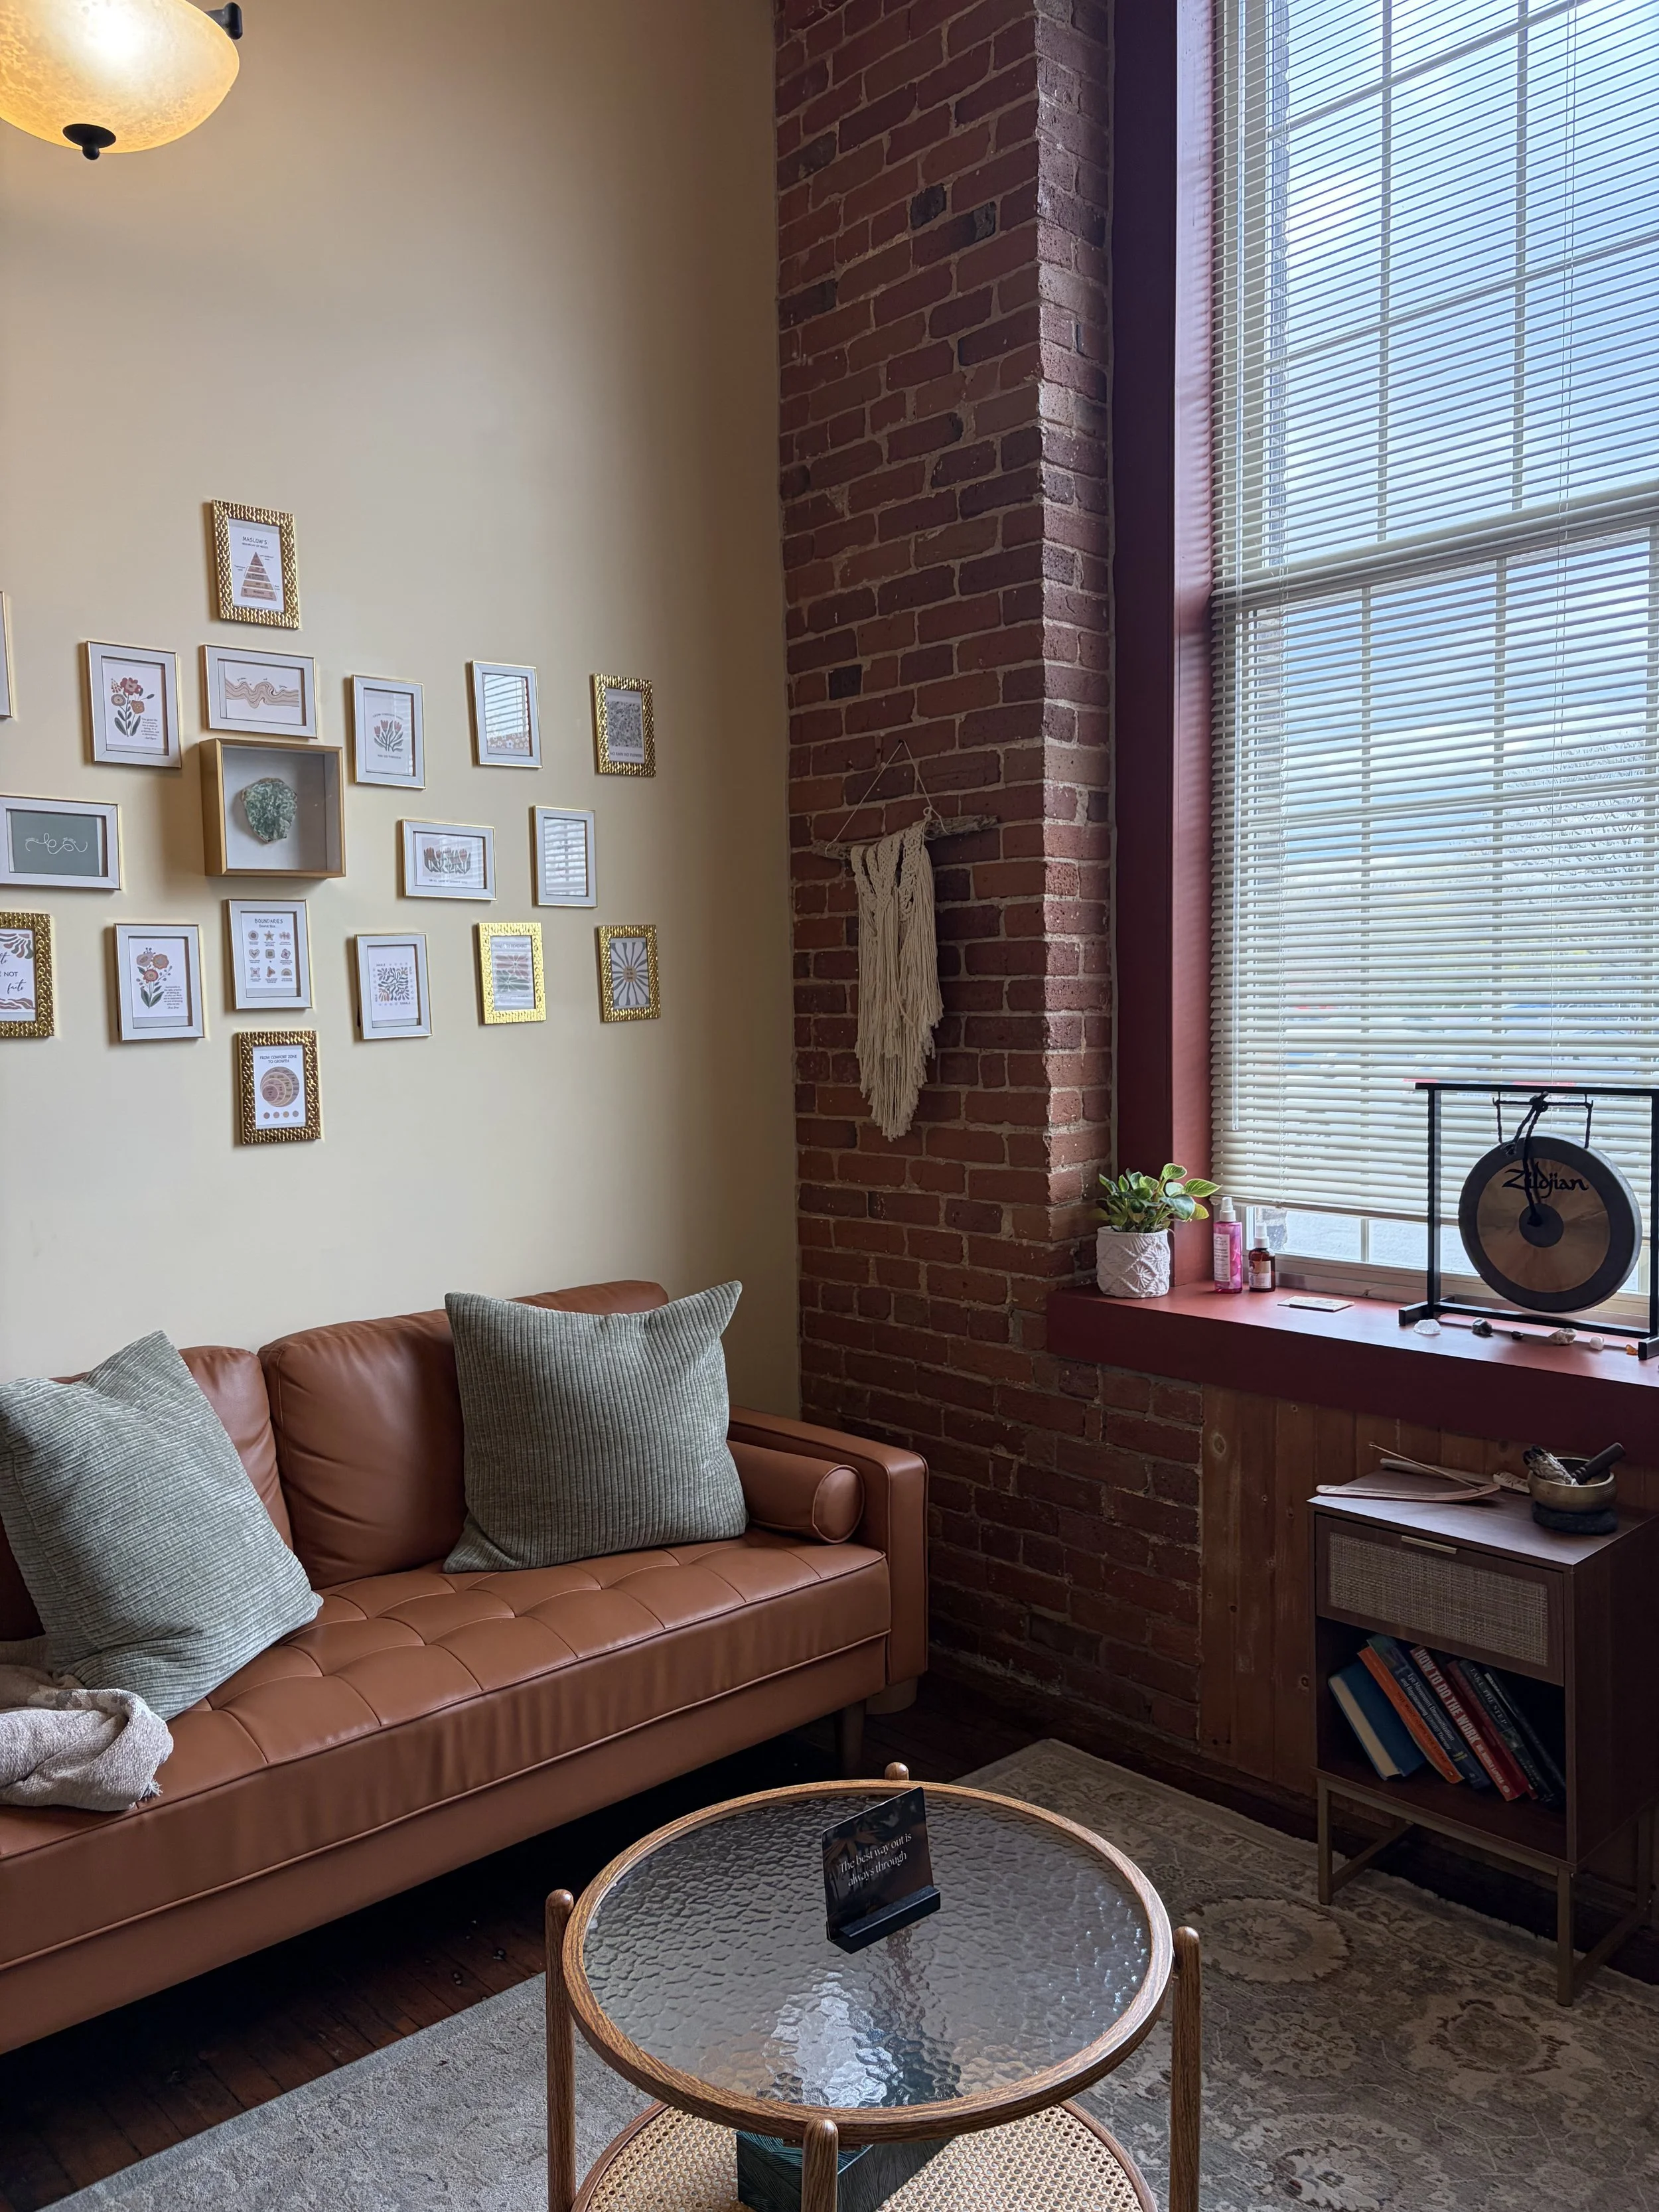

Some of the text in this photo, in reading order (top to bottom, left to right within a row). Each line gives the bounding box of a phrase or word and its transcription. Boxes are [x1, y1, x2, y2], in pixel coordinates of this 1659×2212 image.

[242, 536, 267, 545] MASLOW'S
[7, 979, 27, 994] facts
[1502, 1161, 1589, 1199] Zidjian
[1406, 1672, 1417, 1684] Eye
[1413, 1681, 1433, 1707] Movement
[1413, 1648, 1436, 1673] HOW
[1427, 1669, 1443, 1685] TO
[1435, 1682, 1452, 1699] DO
[1444, 1696, 1463, 1717] THE
[1455, 1714, 1480, 1744] WORK
[1400, 1676, 1409, 1687] and
[1436, 1732, 1452, 1751] Therapy
[839, 1833, 912, 1873] The best way out is
[848, 1851, 907, 1887] always through
